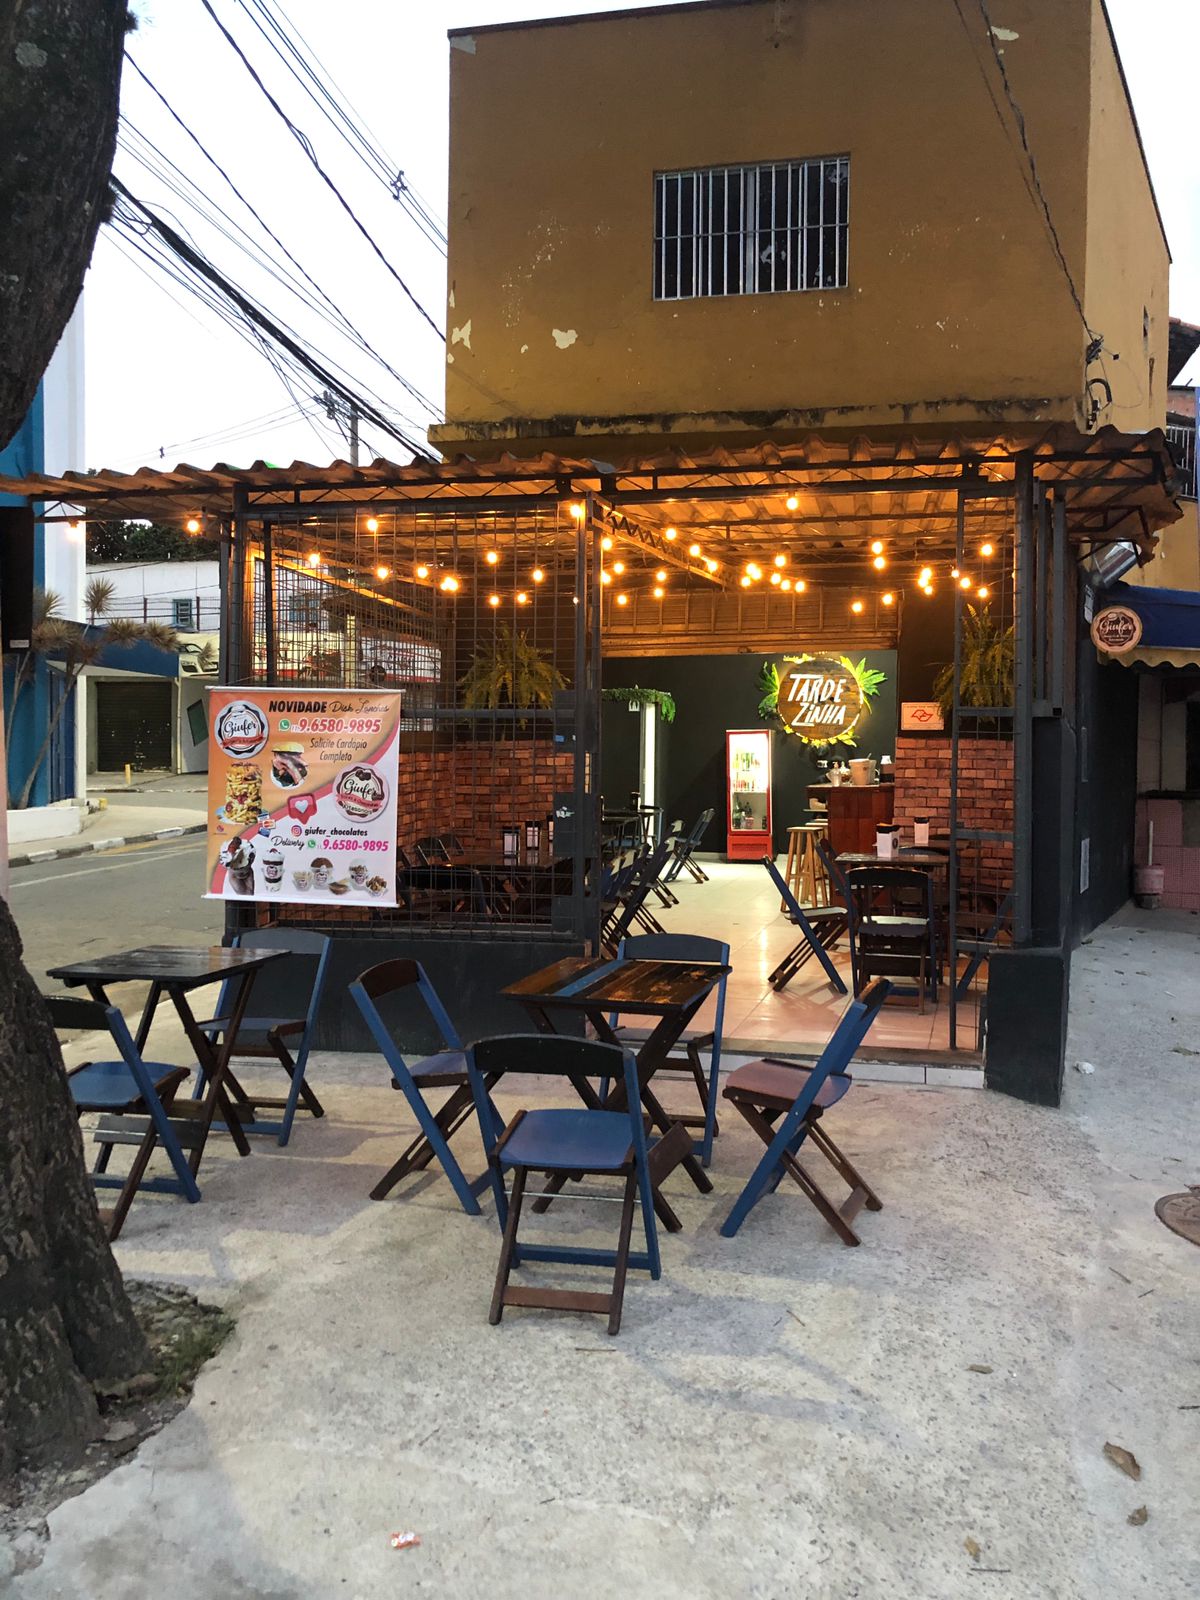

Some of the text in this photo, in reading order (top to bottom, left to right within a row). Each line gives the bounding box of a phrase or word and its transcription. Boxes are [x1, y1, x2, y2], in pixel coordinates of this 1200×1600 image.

[787, 673, 847, 704] TARDE
[268, 700, 328, 713] NOVIDADE
[223, 719, 257, 738] Giufer
[299, 718, 382, 733] 9.6580-9895
[310, 737, 335, 749] Solicite
[319, 750, 353, 763] Completo
[343, 779, 377, 799] Giufer
[304, 826, 368, 837] giufer_chocolates
[271, 835, 305, 850] Delivery
[322, 838, 389, 852] 9.6580-9895
